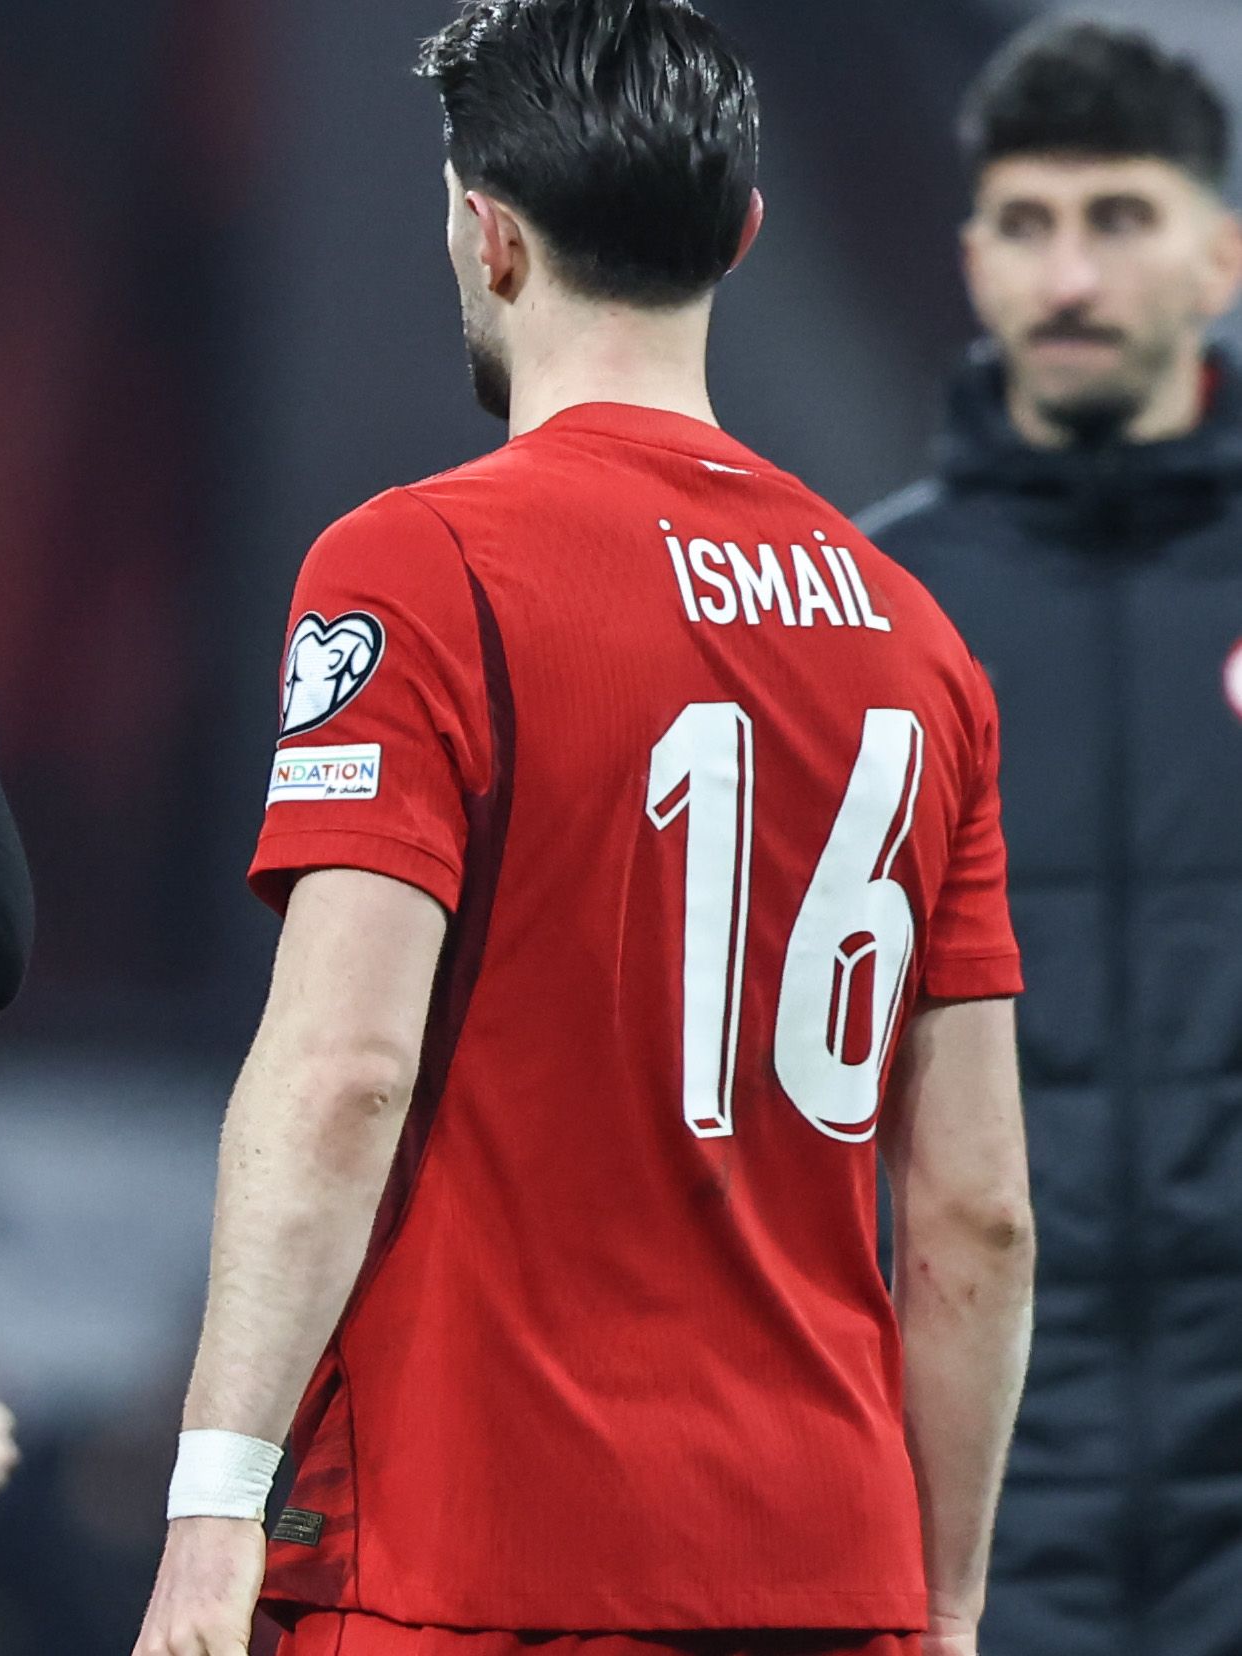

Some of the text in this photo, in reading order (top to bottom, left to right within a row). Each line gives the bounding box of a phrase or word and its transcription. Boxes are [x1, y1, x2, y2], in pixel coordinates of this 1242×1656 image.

[659, 519, 891, 631] İSMAİL
[274, 762, 375, 783] NDATION
[646, 702, 924, 1143] 16
